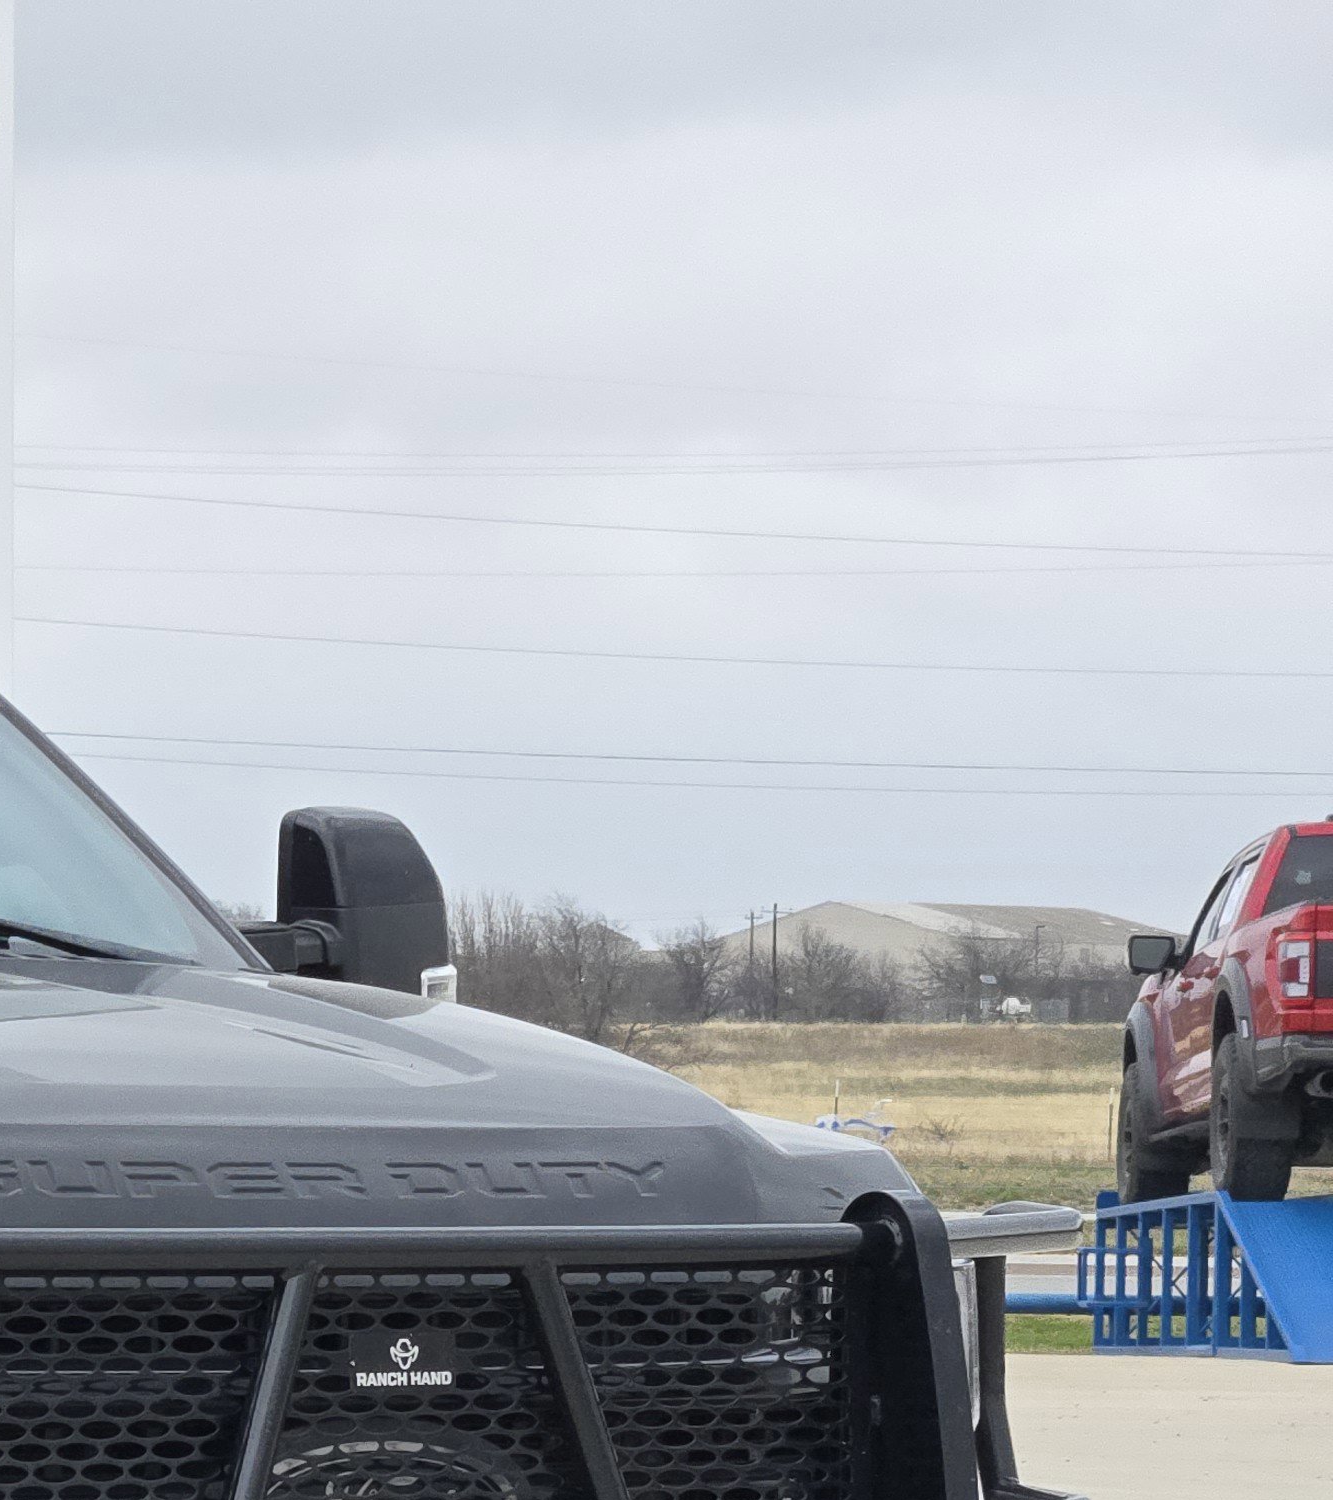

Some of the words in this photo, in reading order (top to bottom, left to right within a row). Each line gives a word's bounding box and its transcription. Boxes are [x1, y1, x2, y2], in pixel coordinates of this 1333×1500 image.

[385, 1158, 663, 1198] DUTY
[356, 1372, 407, 1387] RANCH
[410, 1371, 452, 1386] HAND
